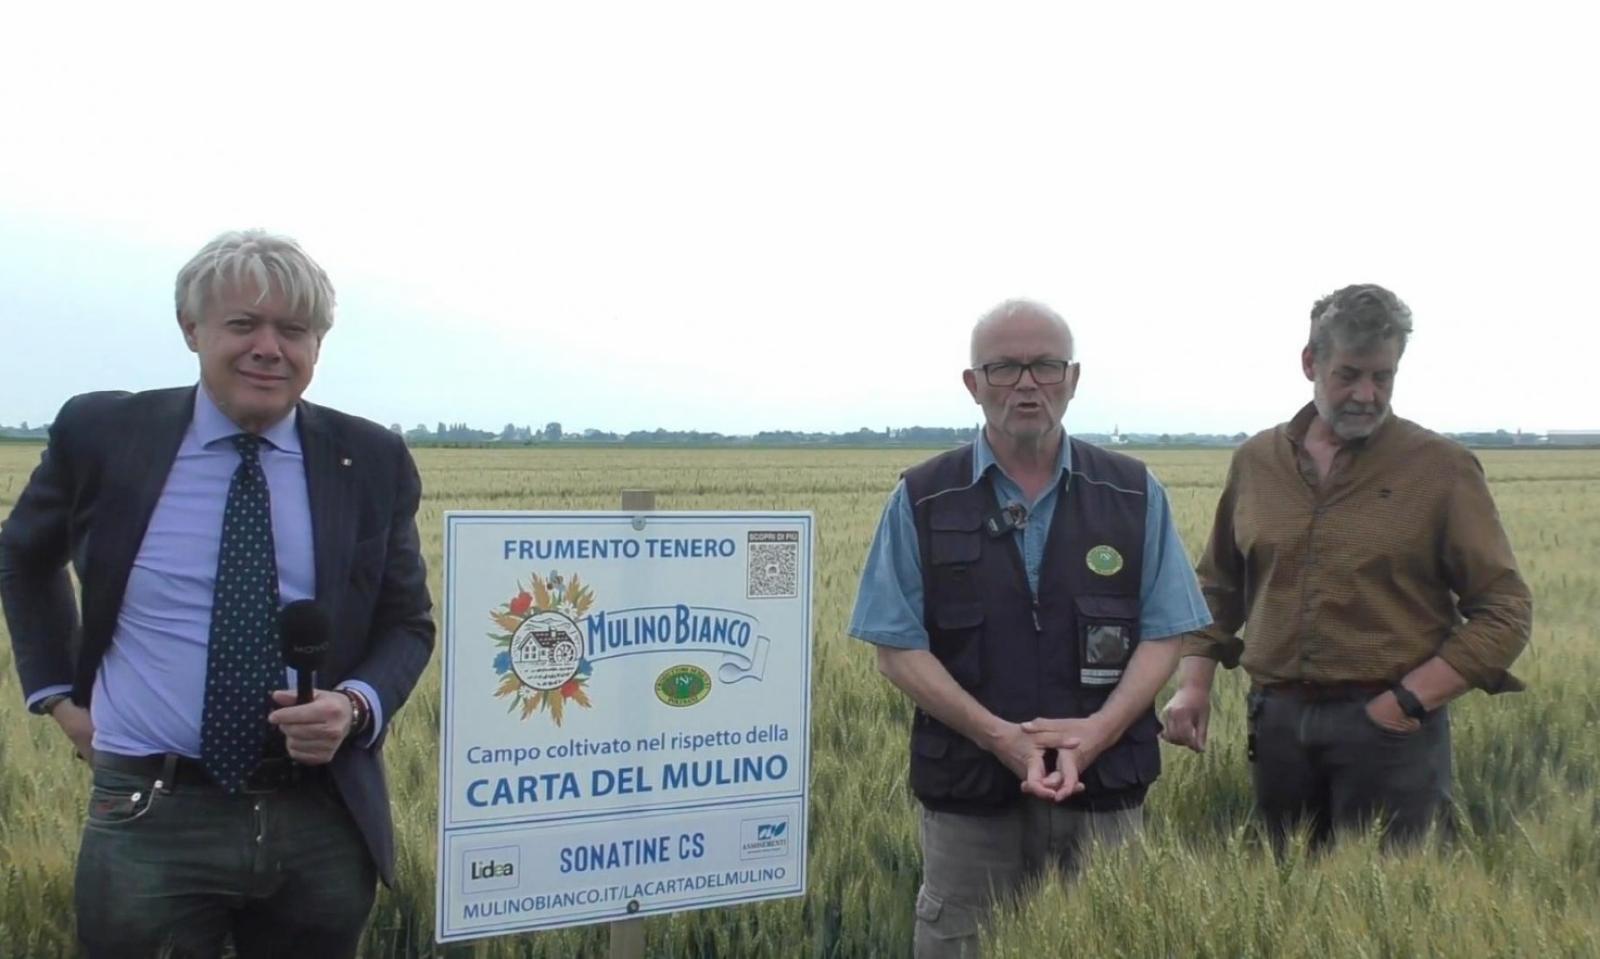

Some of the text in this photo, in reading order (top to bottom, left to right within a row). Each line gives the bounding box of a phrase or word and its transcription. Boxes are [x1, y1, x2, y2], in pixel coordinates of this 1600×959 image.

[503, 538, 736, 560] FRUMENTO TENERO
[467, 723, 789, 766] Campo coltivato nel rispetto della
[466, 754, 788, 808] CARTA DEL MULINO
[471, 859, 514, 880] Lidea
[560, 832, 705, 874] SONATINE CS
[463, 866, 786, 919] MULINOBIANCO.IT/LACARTADELMULINO
